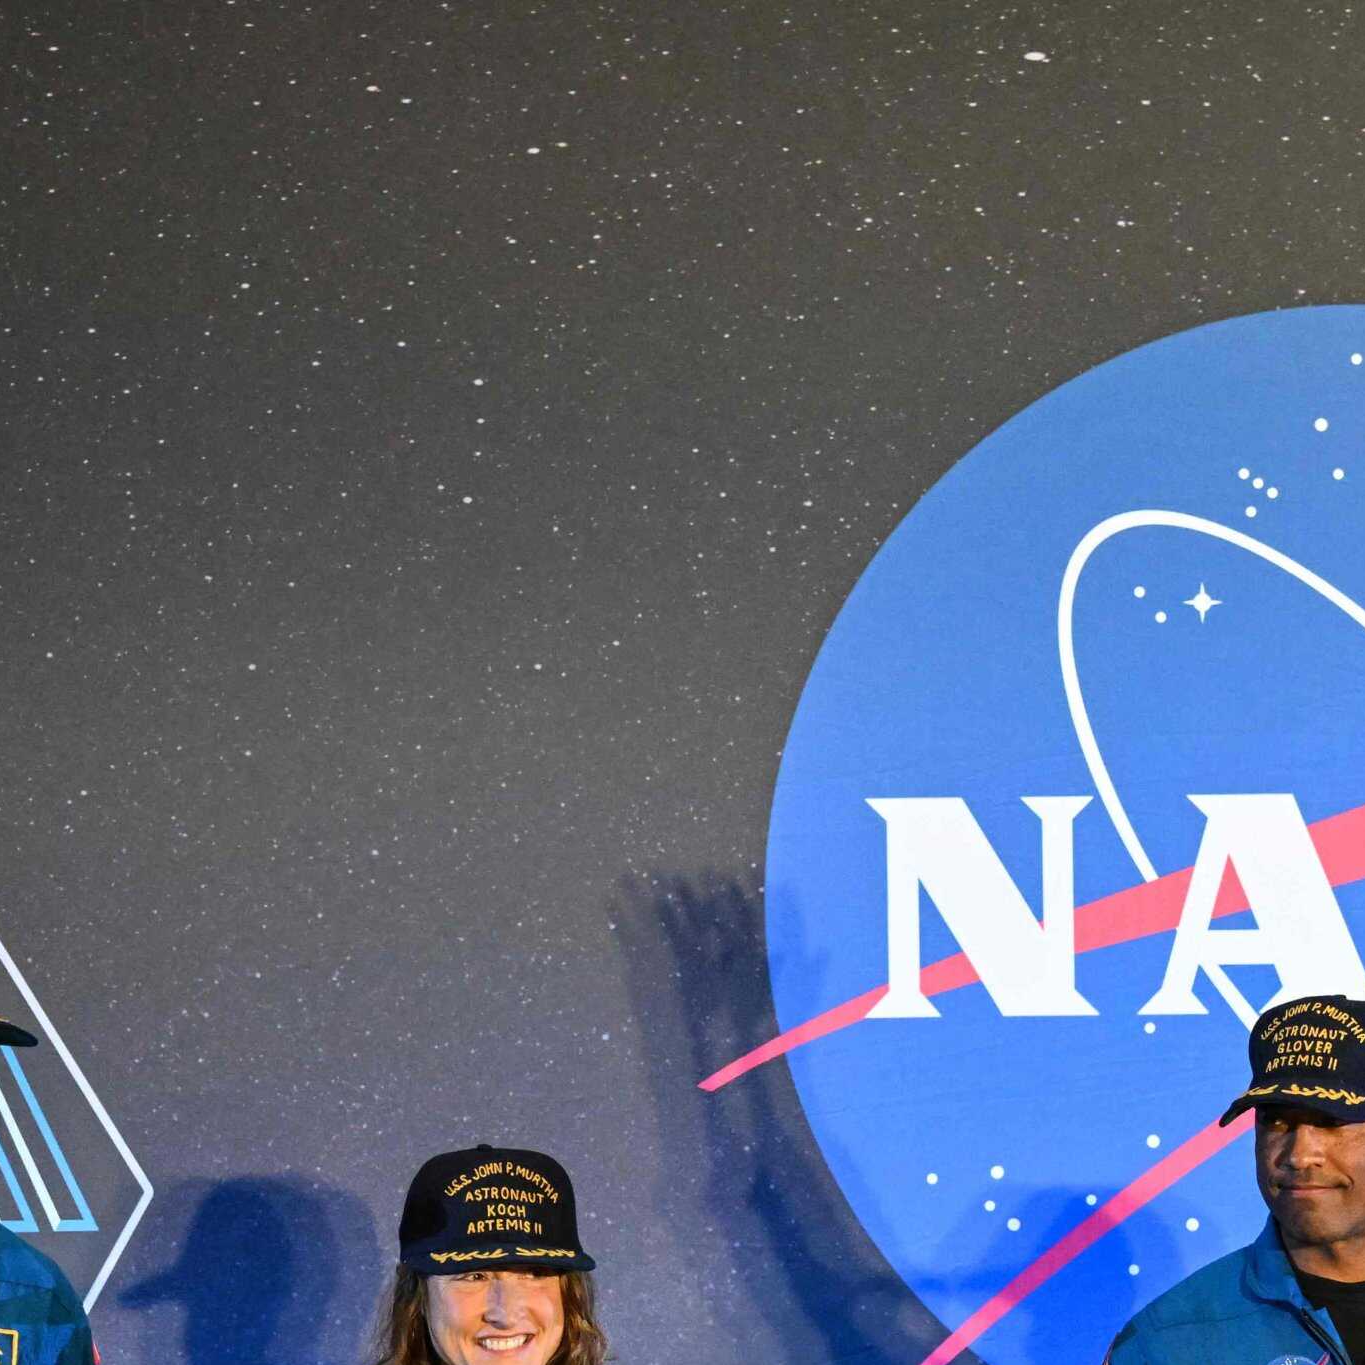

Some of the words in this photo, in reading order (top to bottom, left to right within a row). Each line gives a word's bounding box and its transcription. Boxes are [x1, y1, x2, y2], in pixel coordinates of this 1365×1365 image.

[1282, 1002, 1311, 1021] JOHN
[1272, 1024, 1348, 1044] ASTRONAUT
[1277, 1040, 1333, 1054] GLOVER
[1265, 1055, 1323, 1073] ARTEMIS
[1327, 1057, 1338, 1071] II
[472, 1162, 503, 1181] JOHN
[506, 1161, 515, 1177] P.
[515, 1165, 559, 1204] MURTHA
[465, 1186, 545, 1204] ASTRONAUT
[487, 1203, 527, 1218] KOCH
[467, 1219, 532, 1235] ARTEMIS
[534, 1222, 543, 1235] II
